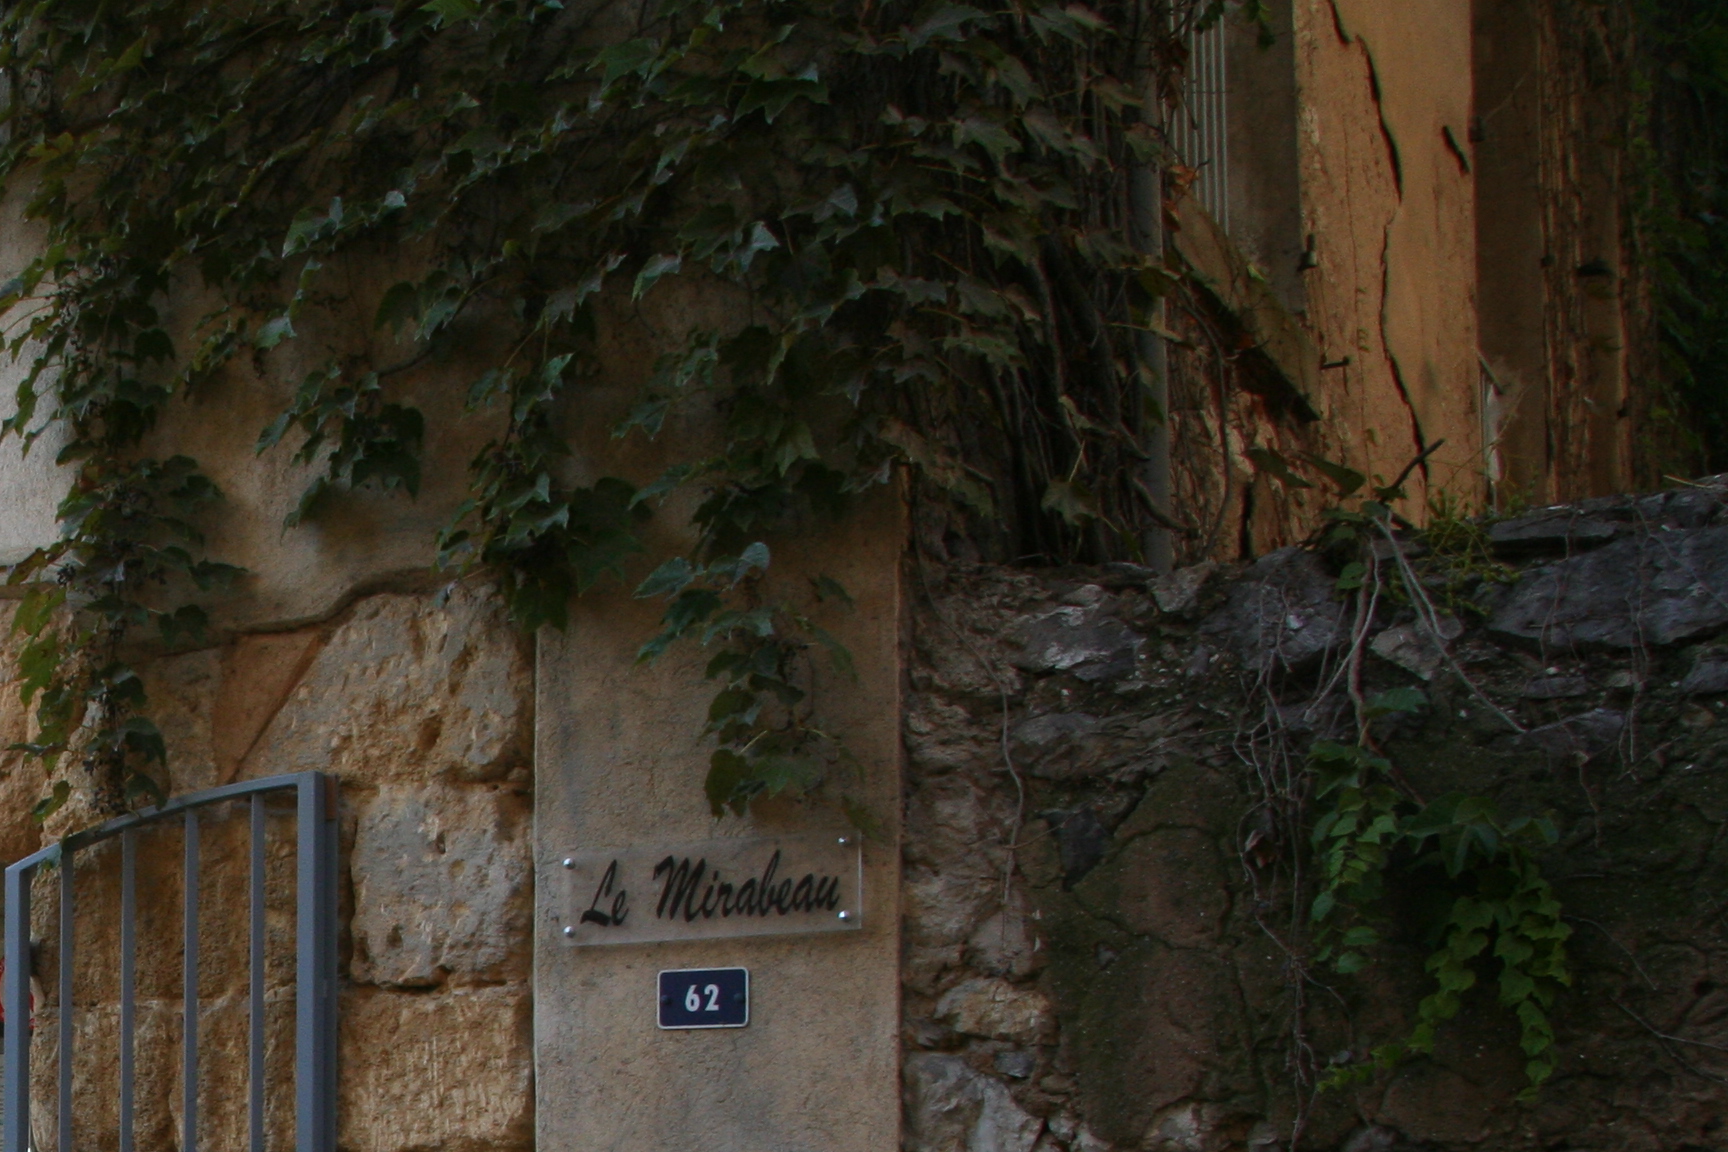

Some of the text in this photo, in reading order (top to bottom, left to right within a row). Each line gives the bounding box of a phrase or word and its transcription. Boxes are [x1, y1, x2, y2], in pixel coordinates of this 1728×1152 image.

[580, 850, 840, 926] Le Mirabeau
[685, 984, 720, 1012] 62
